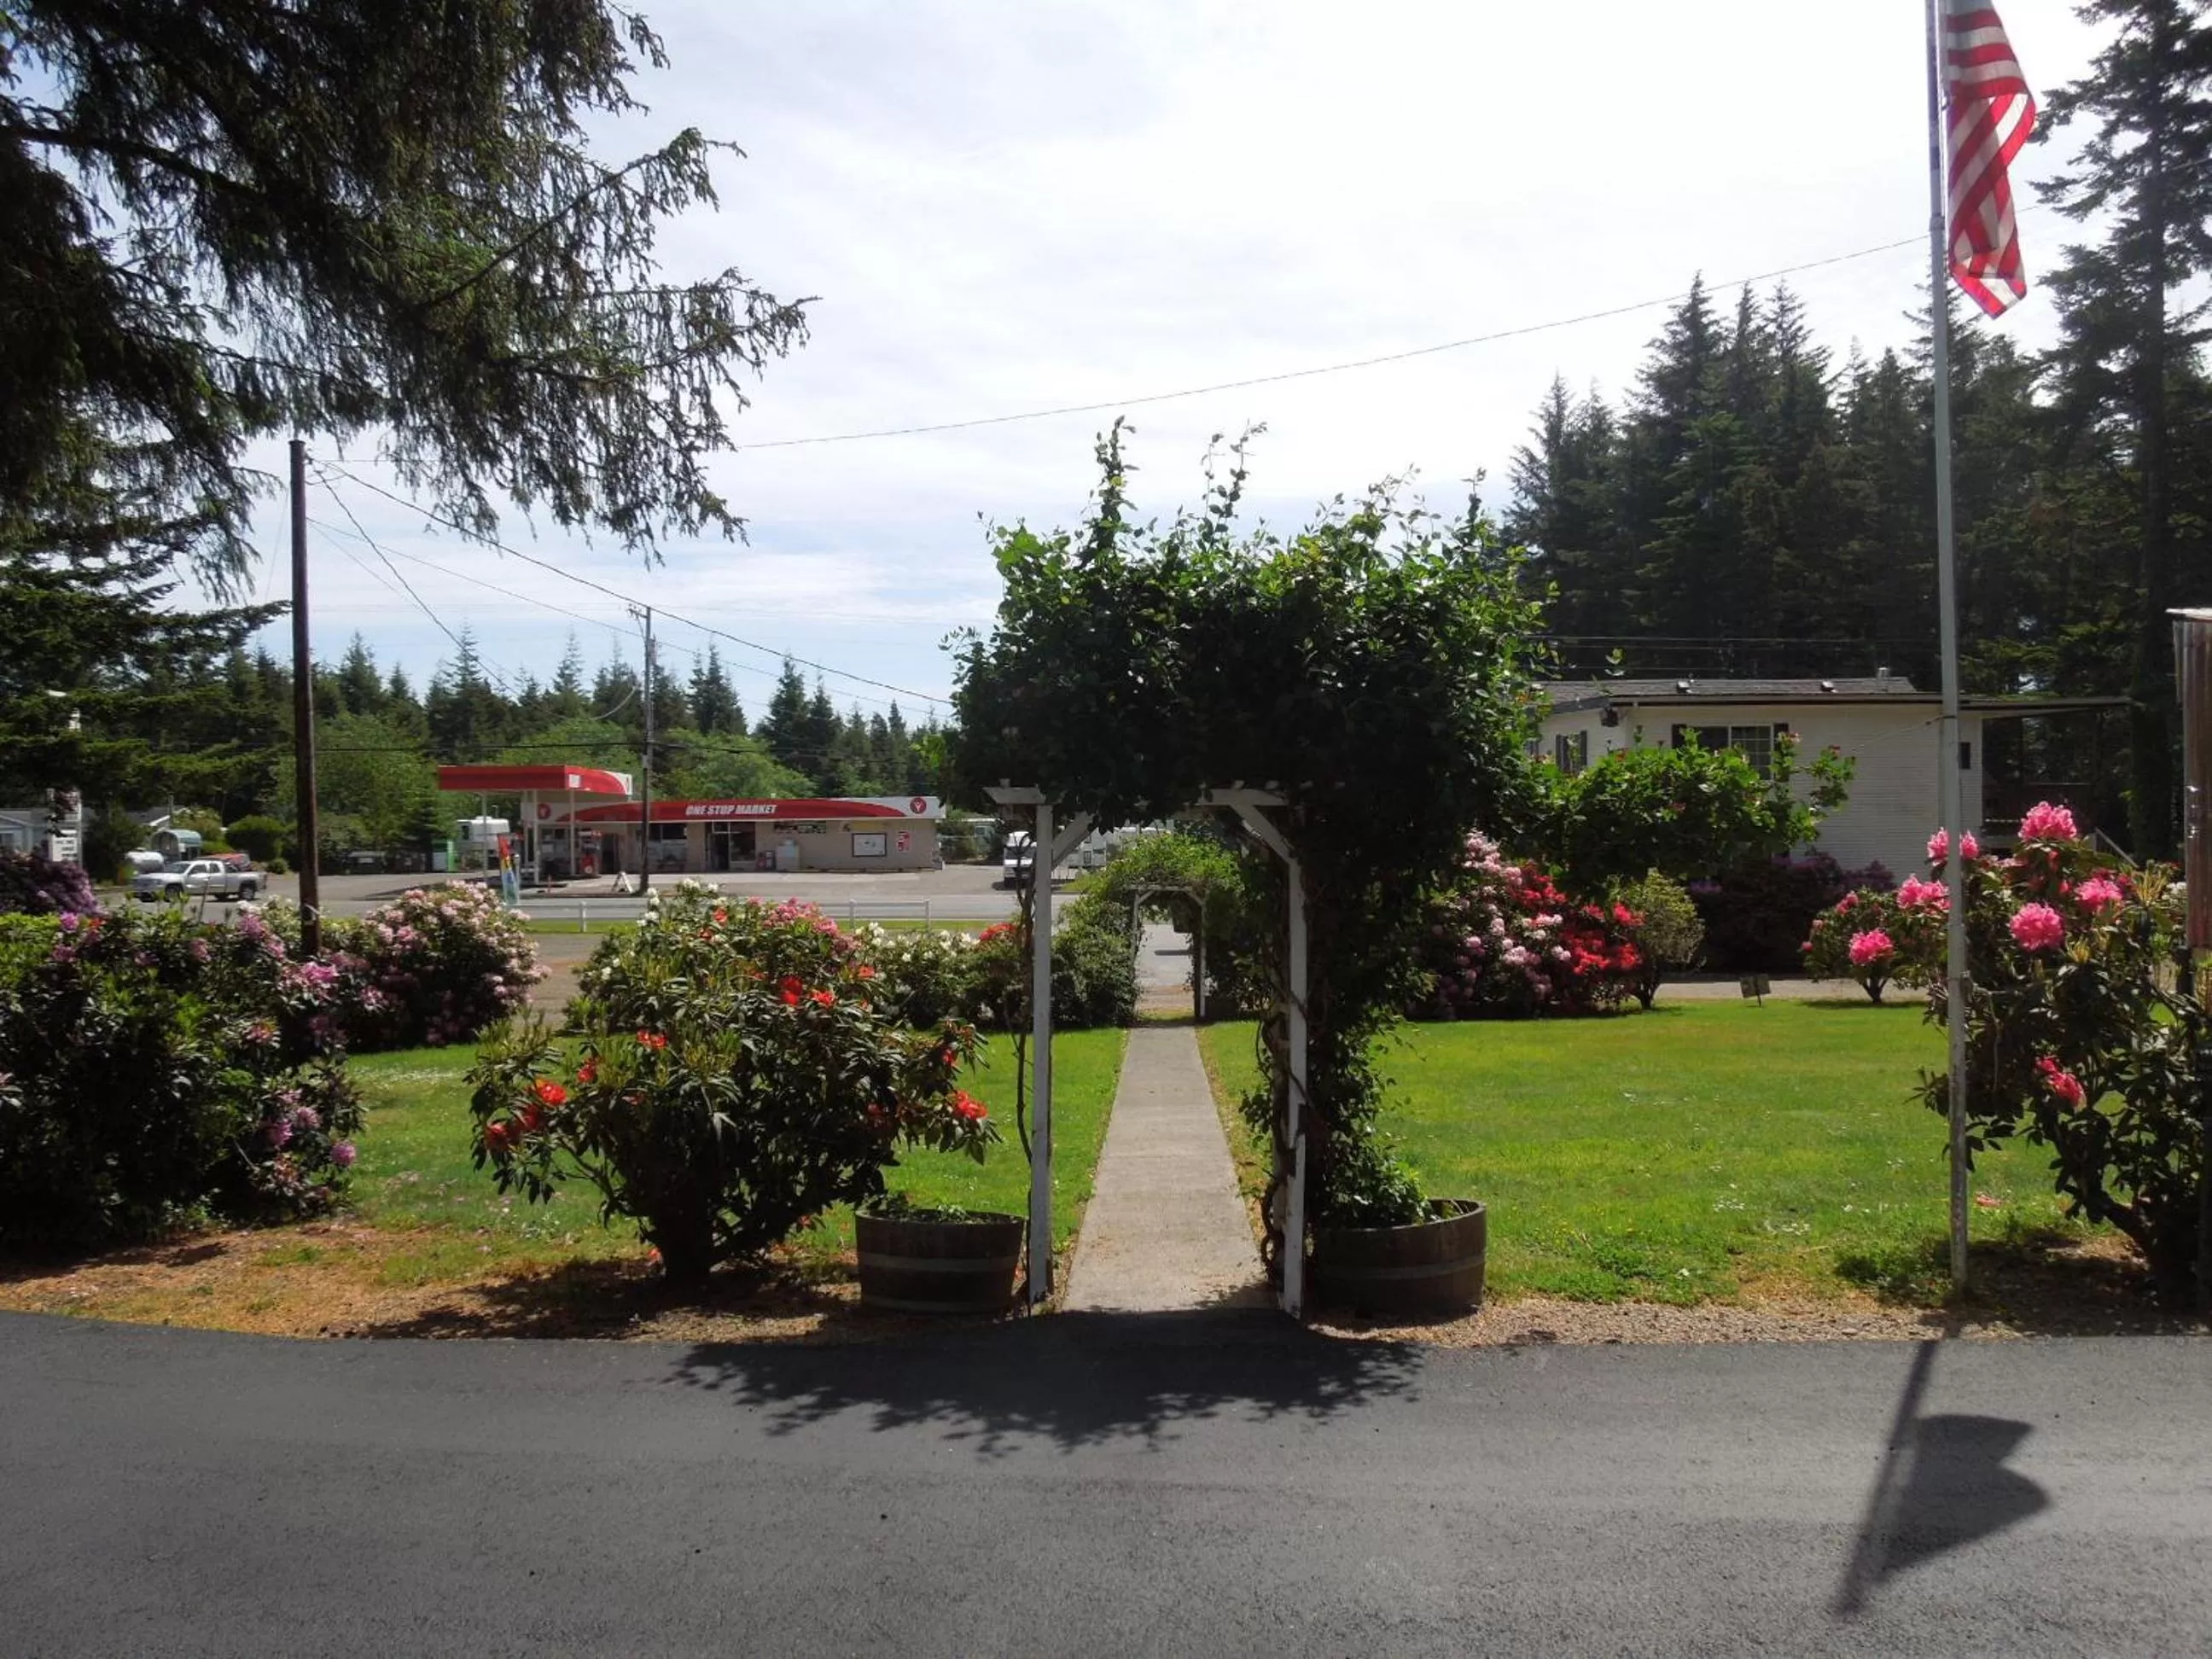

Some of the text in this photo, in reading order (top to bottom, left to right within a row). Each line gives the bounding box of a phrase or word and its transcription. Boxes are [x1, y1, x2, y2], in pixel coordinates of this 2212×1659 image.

[685, 804, 777, 815] ONE STOP MARKET
